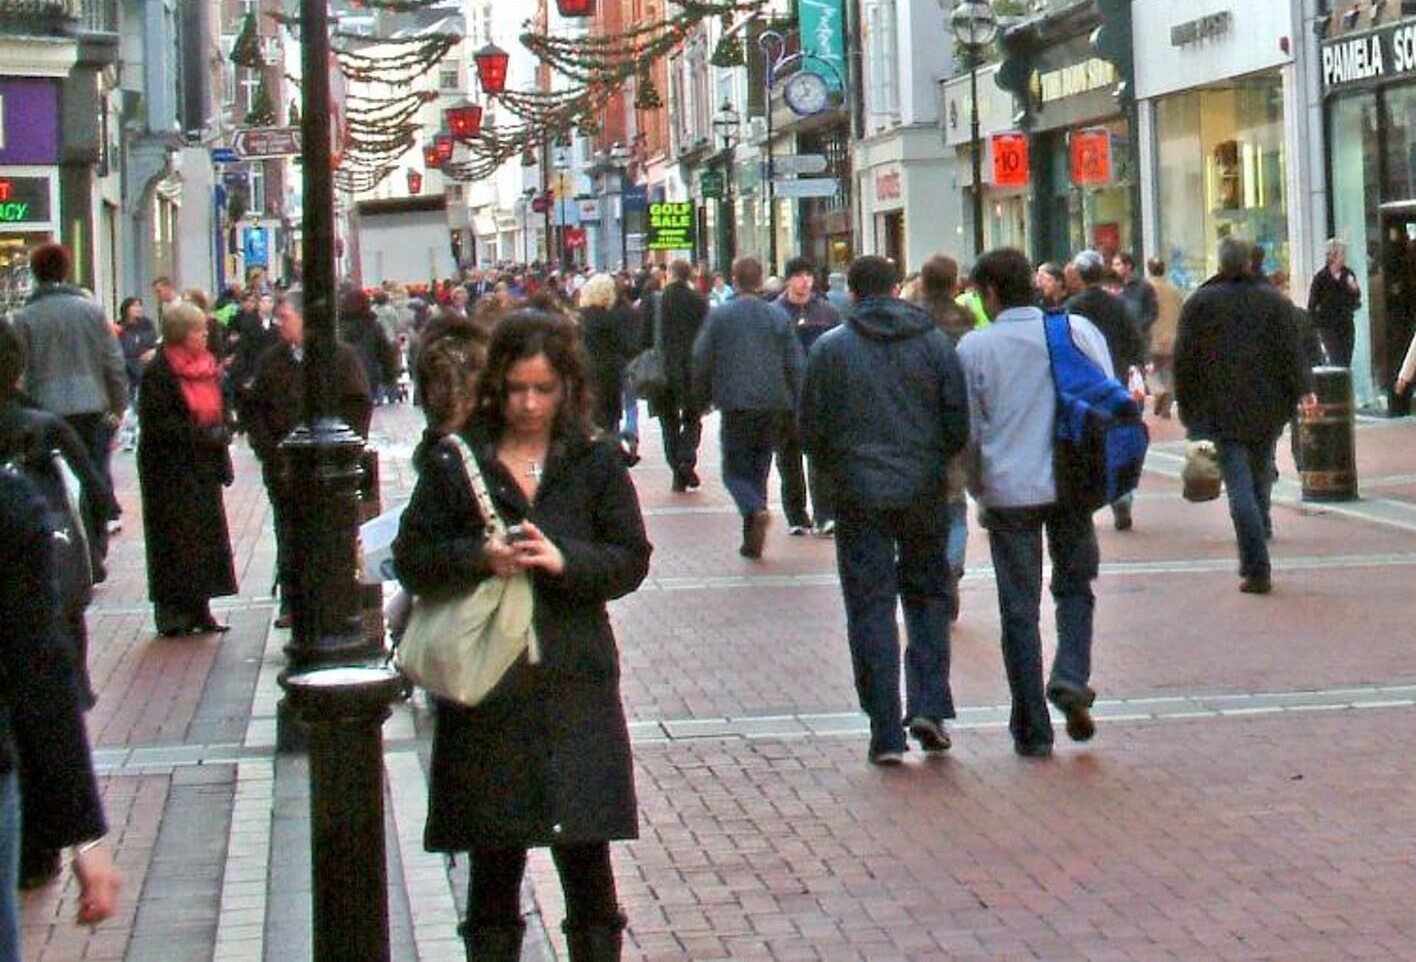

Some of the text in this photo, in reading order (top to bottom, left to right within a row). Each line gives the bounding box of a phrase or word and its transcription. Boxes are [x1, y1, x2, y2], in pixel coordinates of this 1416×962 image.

[1322, 34, 1384, 87] PAMELA
[650, 203, 692, 216] GOLF
[650, 215, 691, 227] SALE
